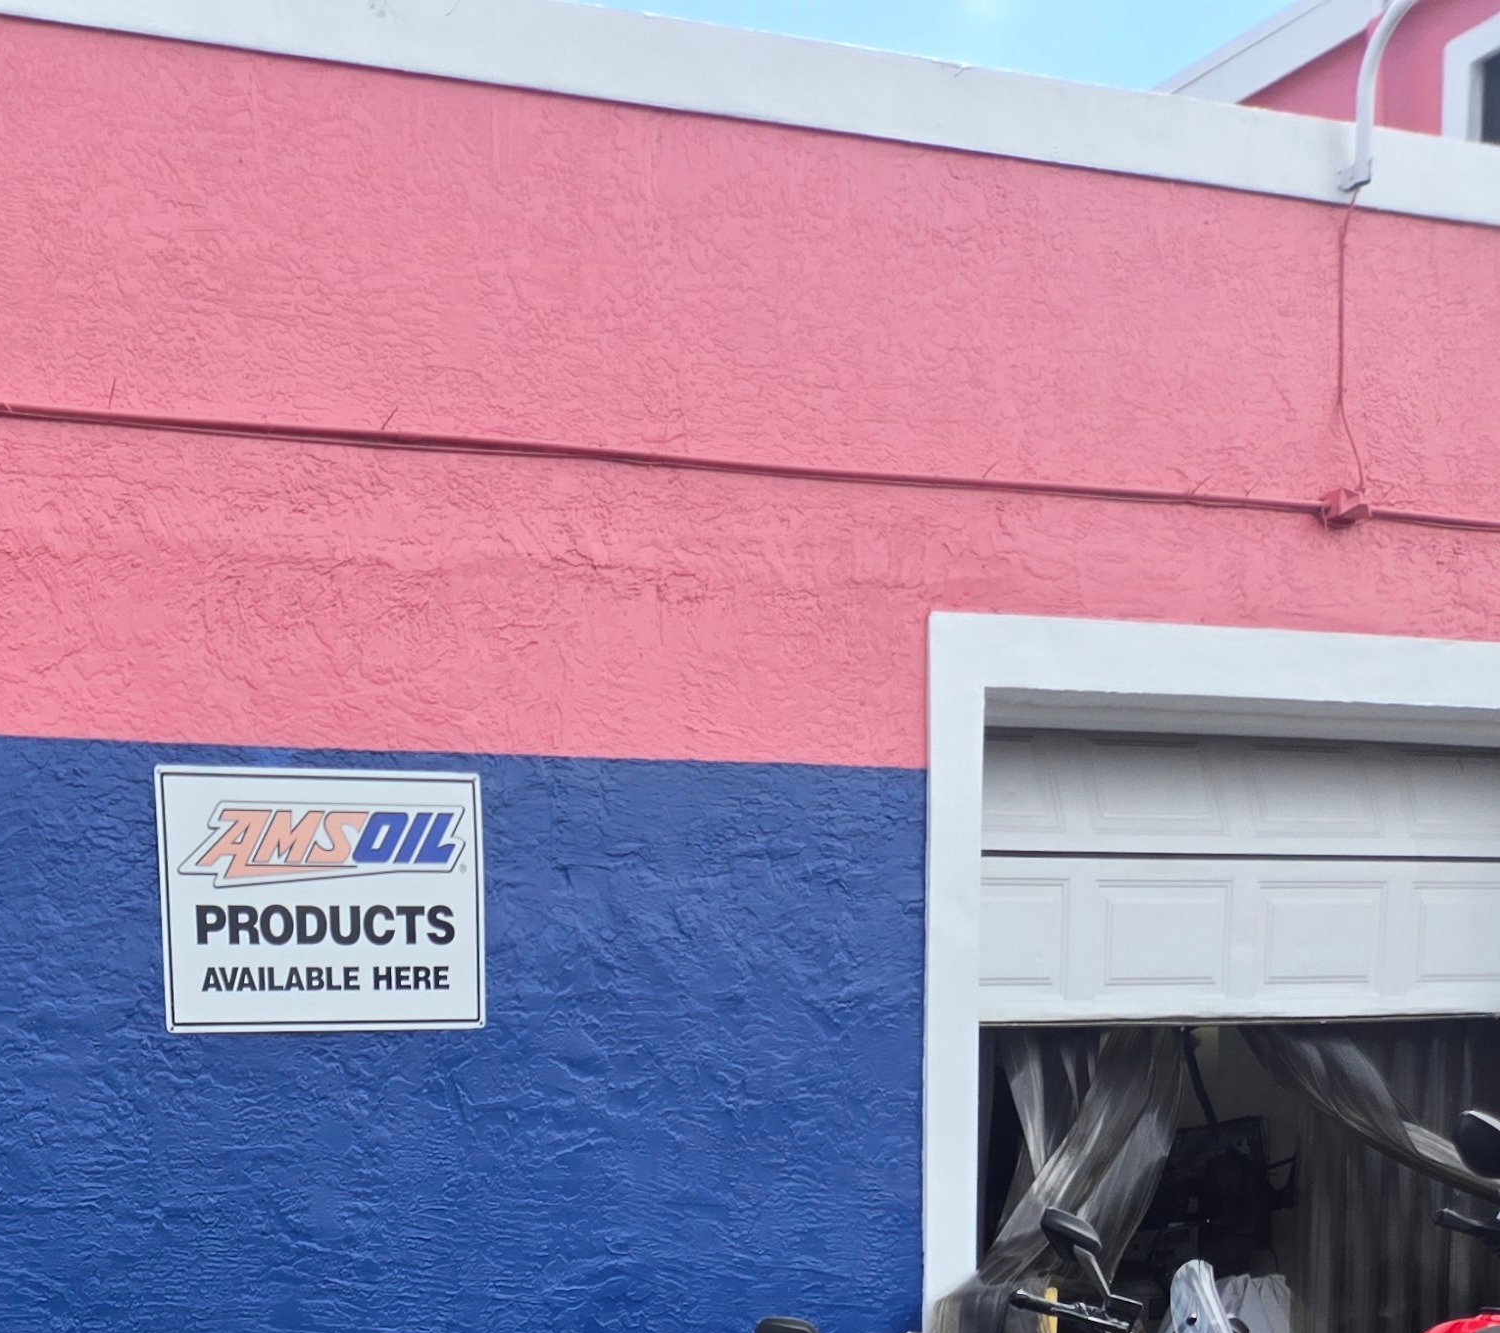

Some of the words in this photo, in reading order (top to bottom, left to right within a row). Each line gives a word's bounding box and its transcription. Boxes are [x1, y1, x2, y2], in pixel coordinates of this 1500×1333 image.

[195, 808, 461, 879] AMSOIL
[195, 904, 456, 945] PRODUCTS
[201, 966, 360, 992] AVAILABLE
[373, 966, 450, 990] HERE
